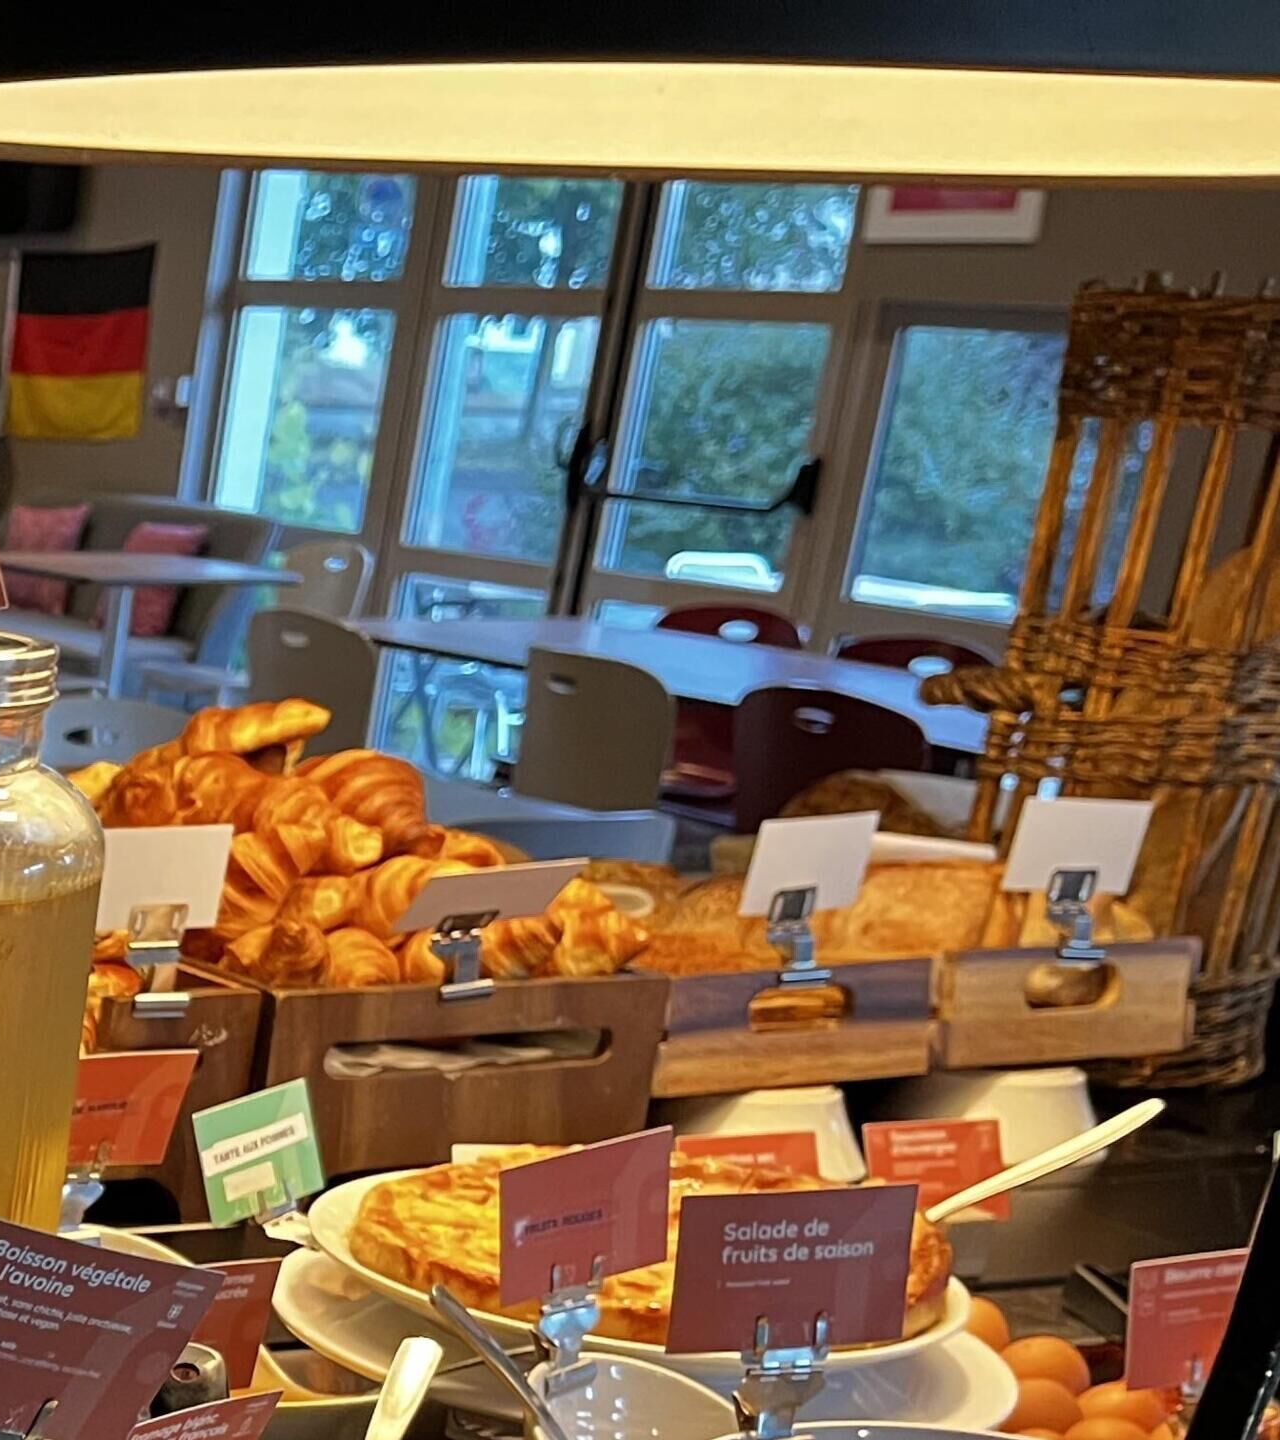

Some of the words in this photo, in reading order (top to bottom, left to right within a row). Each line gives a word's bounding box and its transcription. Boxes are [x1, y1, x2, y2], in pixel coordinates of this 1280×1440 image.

[723, 1219, 798, 1241] Salade
[804, 1218, 830, 1237] de
[722, 1244, 777, 1265] fruits
[783, 1243, 809, 1261] de
[814, 1239, 875, 1260] saison
[71, 1262, 152, 1293] végétale
[11, 1298, 33, 1312] sans
[19, 1311, 30, 1325] et
[30, 1314, 60, 1332] vegan
